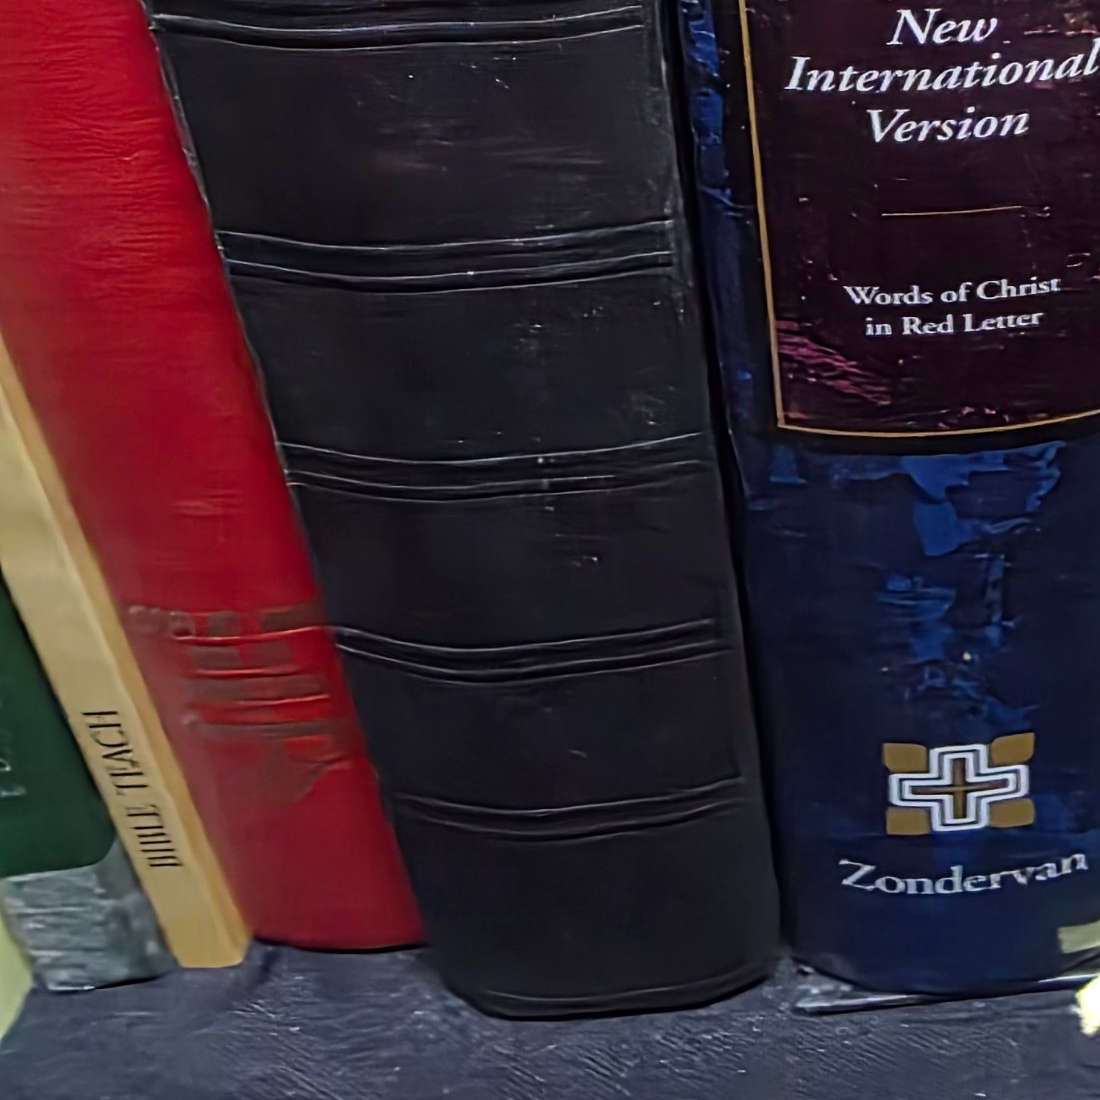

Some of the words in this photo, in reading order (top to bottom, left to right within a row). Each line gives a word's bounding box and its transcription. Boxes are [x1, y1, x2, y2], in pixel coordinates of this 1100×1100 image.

[886, 8, 998, 46] New
[866, 106, 1031, 143] Version
[843, 285, 933, 306] Words
[940, 282, 974, 304] of
[976, 275, 1061, 300] Christ
[865, 317, 893, 337] in
[902, 313, 956, 335] Red
[963, 311, 1045, 334] Letter
[838, 852, 1089, 895] Zondervan
